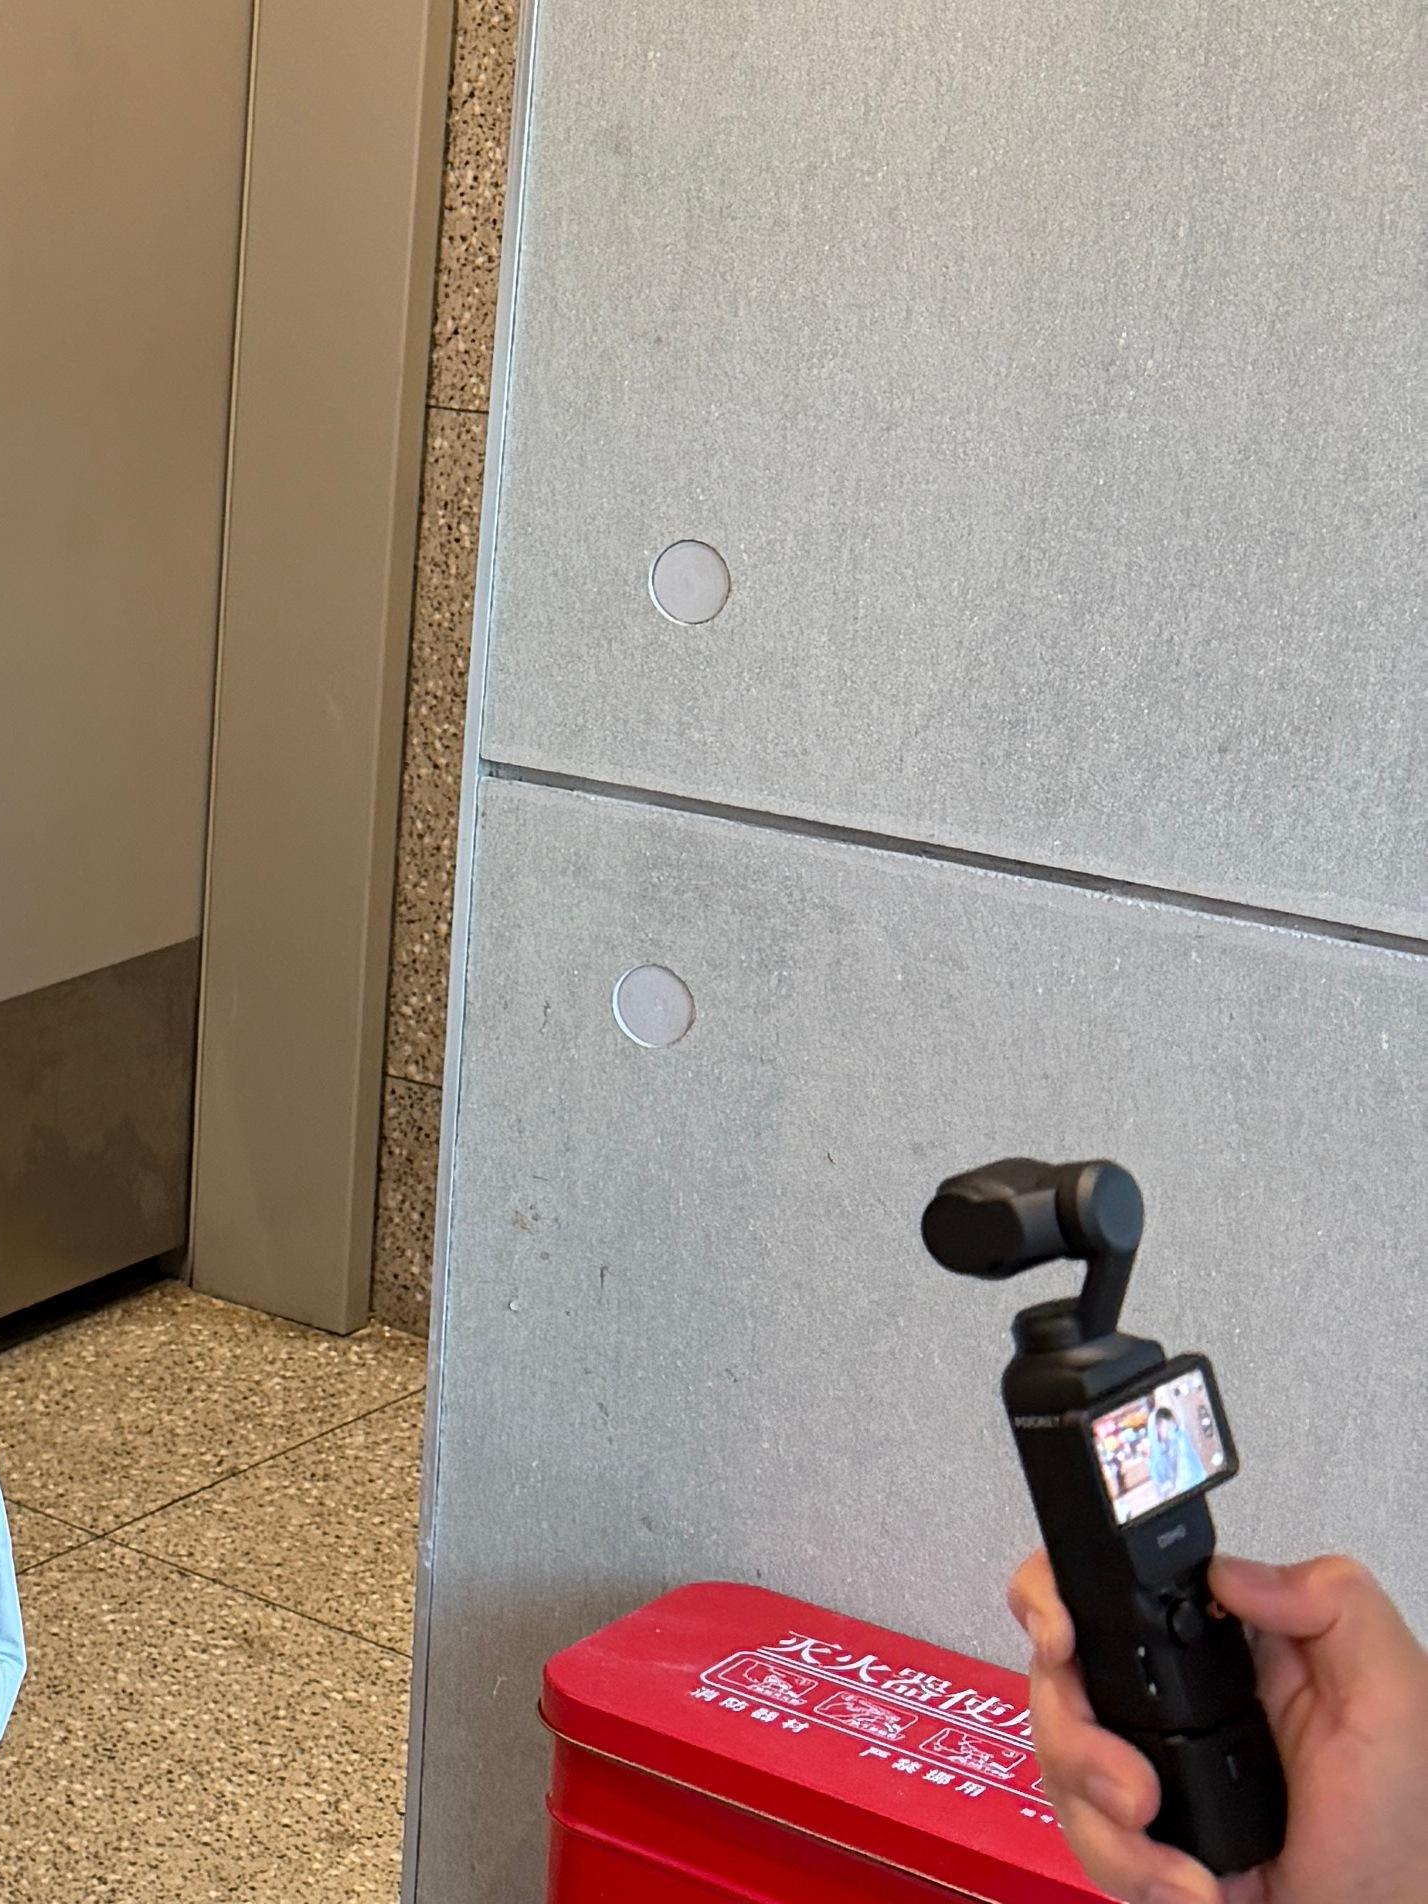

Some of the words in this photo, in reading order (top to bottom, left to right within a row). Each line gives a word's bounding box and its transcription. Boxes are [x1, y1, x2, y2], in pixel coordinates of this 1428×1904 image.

[690, 1686, 810, 1734] 消防器材
[859, 1746, 988, 1797] 严禁挪用
